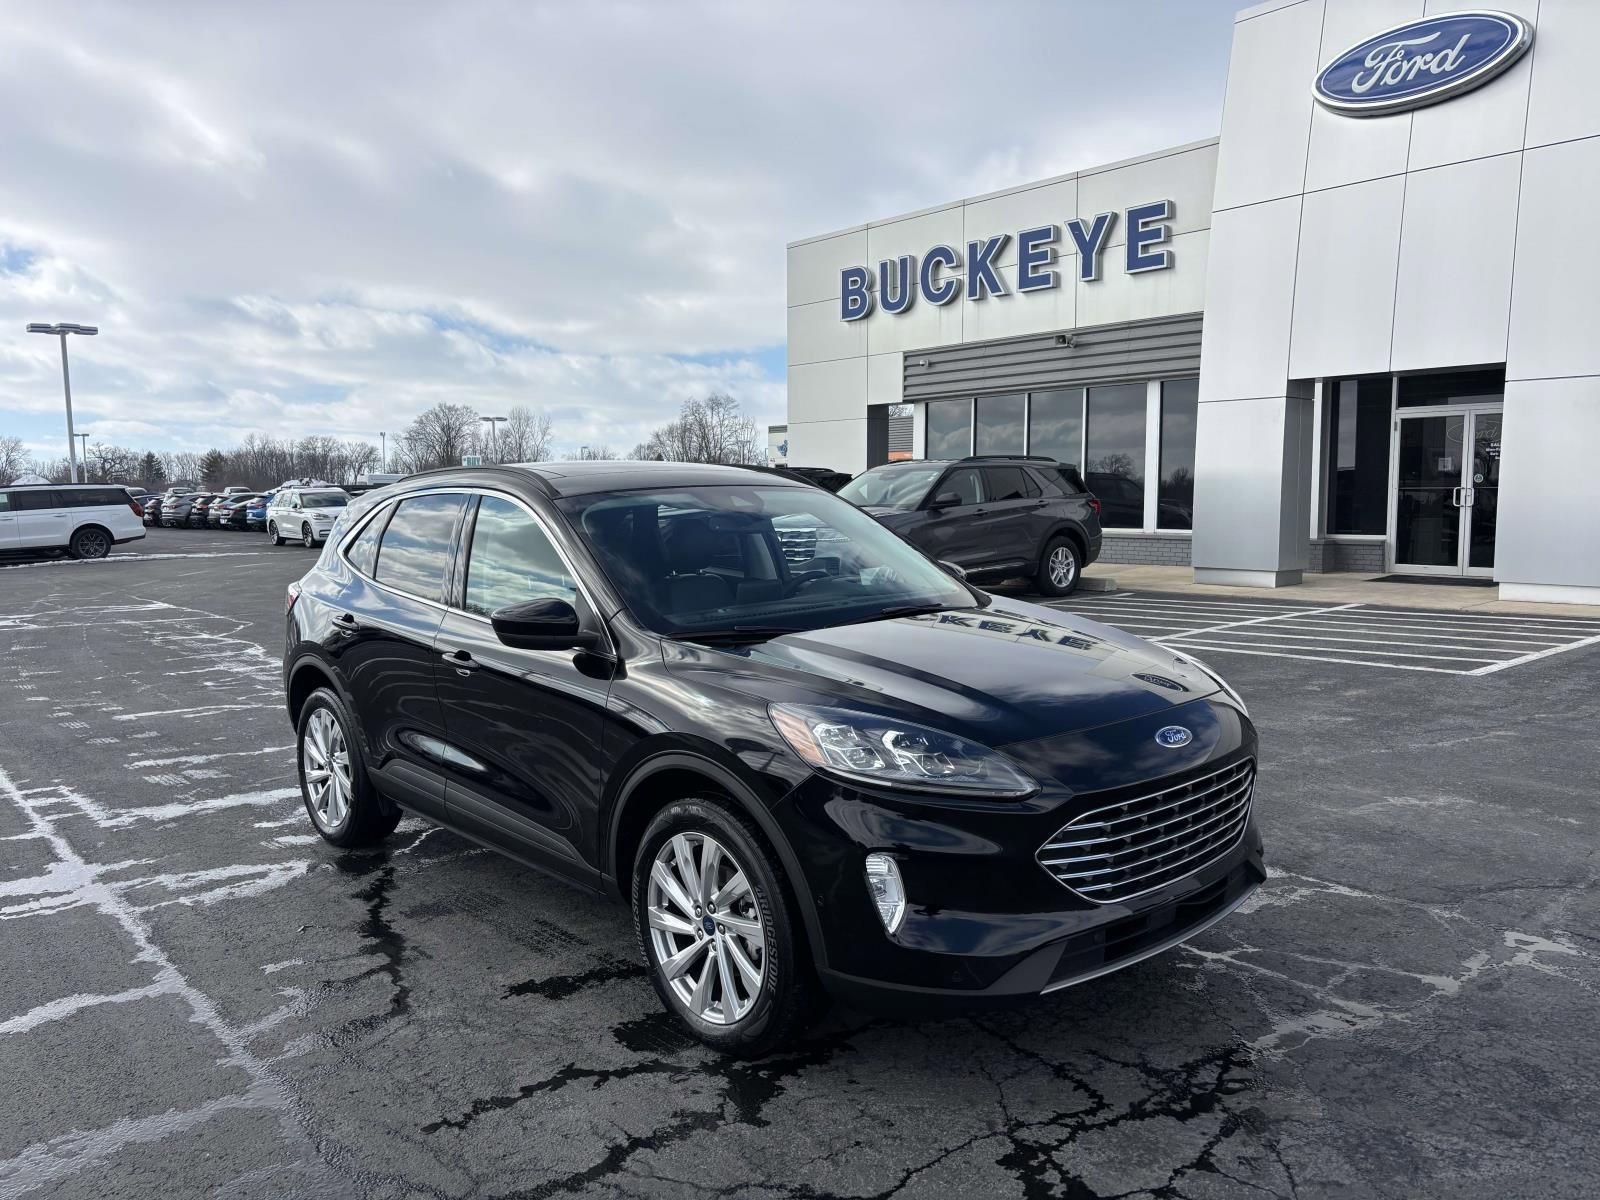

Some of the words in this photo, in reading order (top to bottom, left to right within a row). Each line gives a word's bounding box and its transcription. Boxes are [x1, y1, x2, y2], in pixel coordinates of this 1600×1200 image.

[1351, 31, 1471, 94] Ford
[840, 199, 1173, 322] BUCKEYE
[1164, 729, 1187, 743] Ford
[755, 886, 779, 996] BRIDGESTONE
